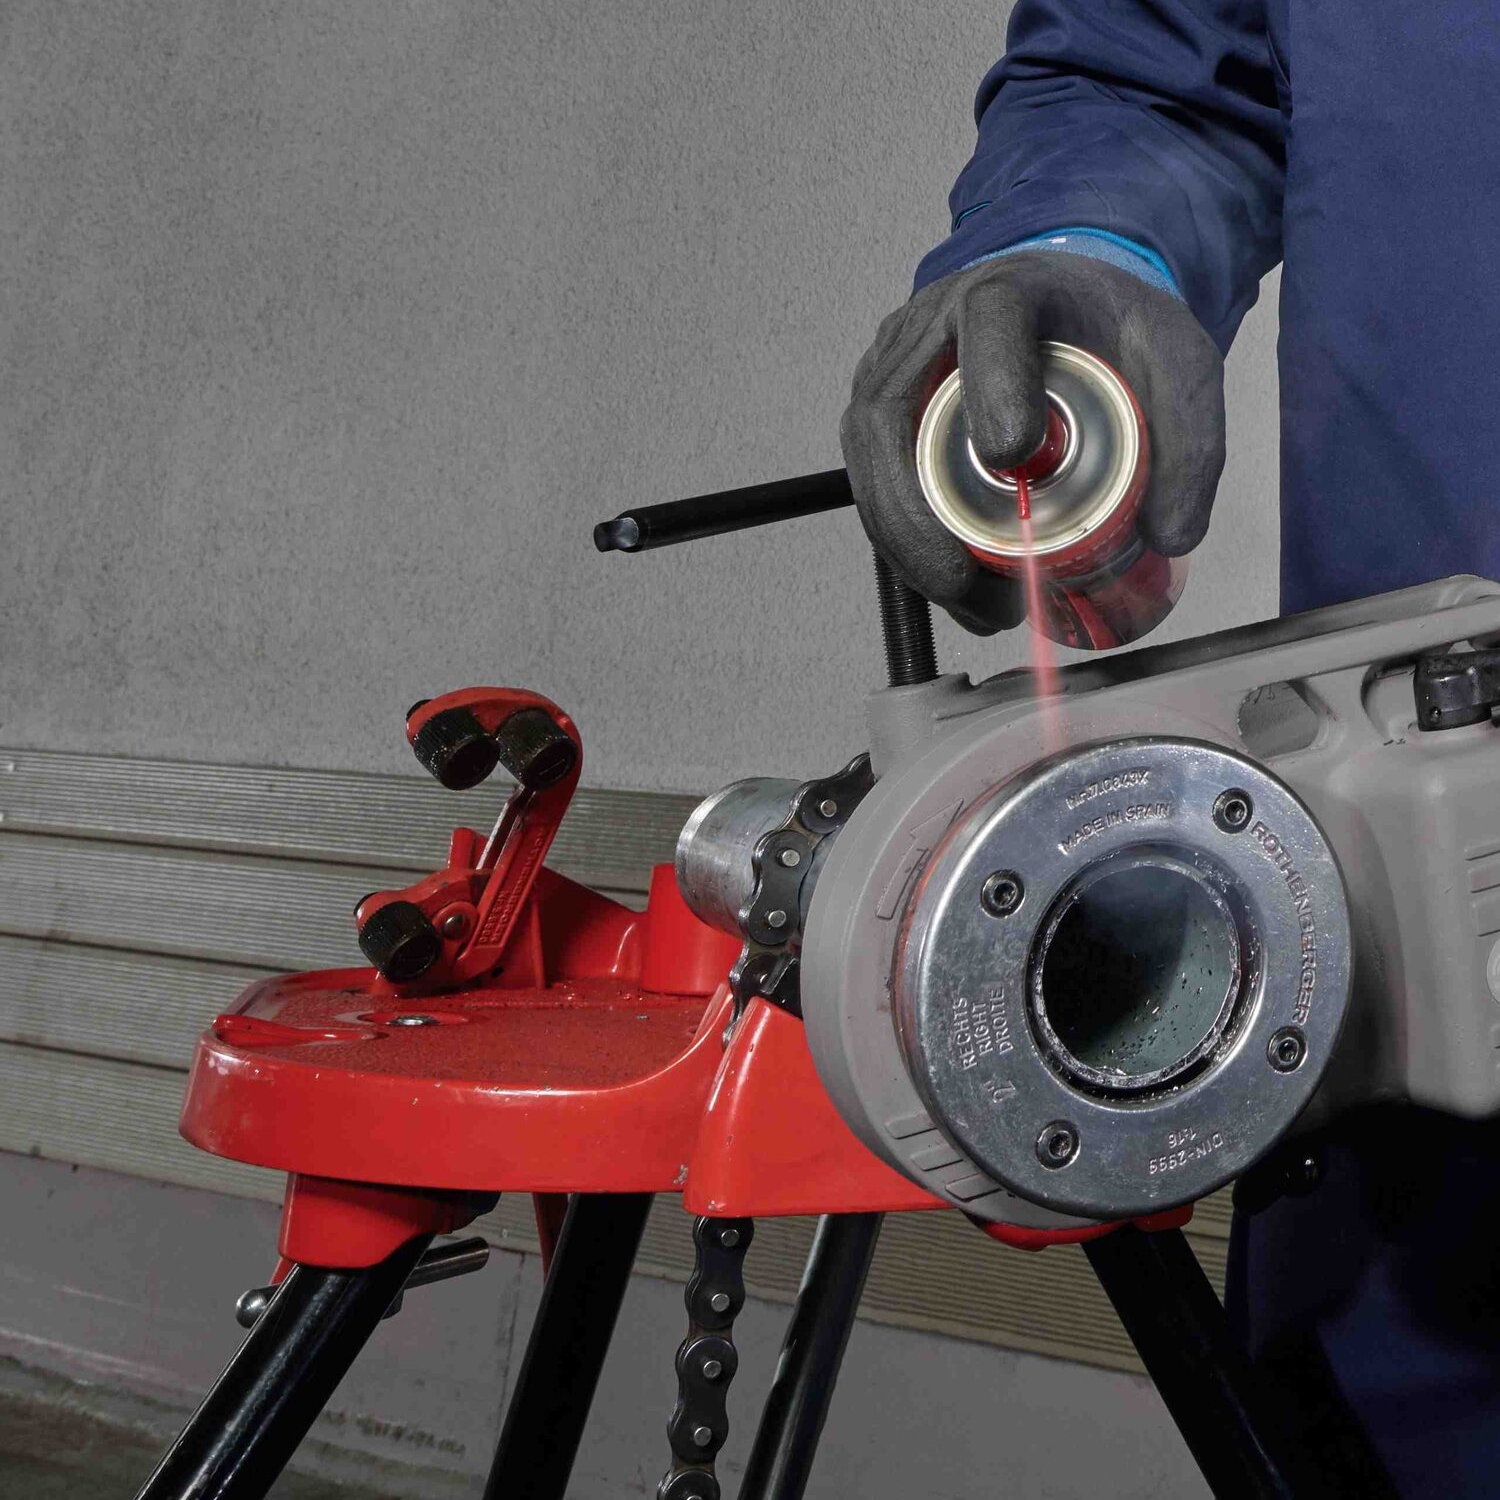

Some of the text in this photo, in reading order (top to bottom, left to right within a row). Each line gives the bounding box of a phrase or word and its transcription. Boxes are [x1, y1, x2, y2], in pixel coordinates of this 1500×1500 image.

[1057, 802, 1171, 856] MADE IN SPAIN
[952, 997, 978, 1071] RECHTS
[970, 1002, 994, 1056] RIGHT
[989, 987, 1014, 1056] DROITE
